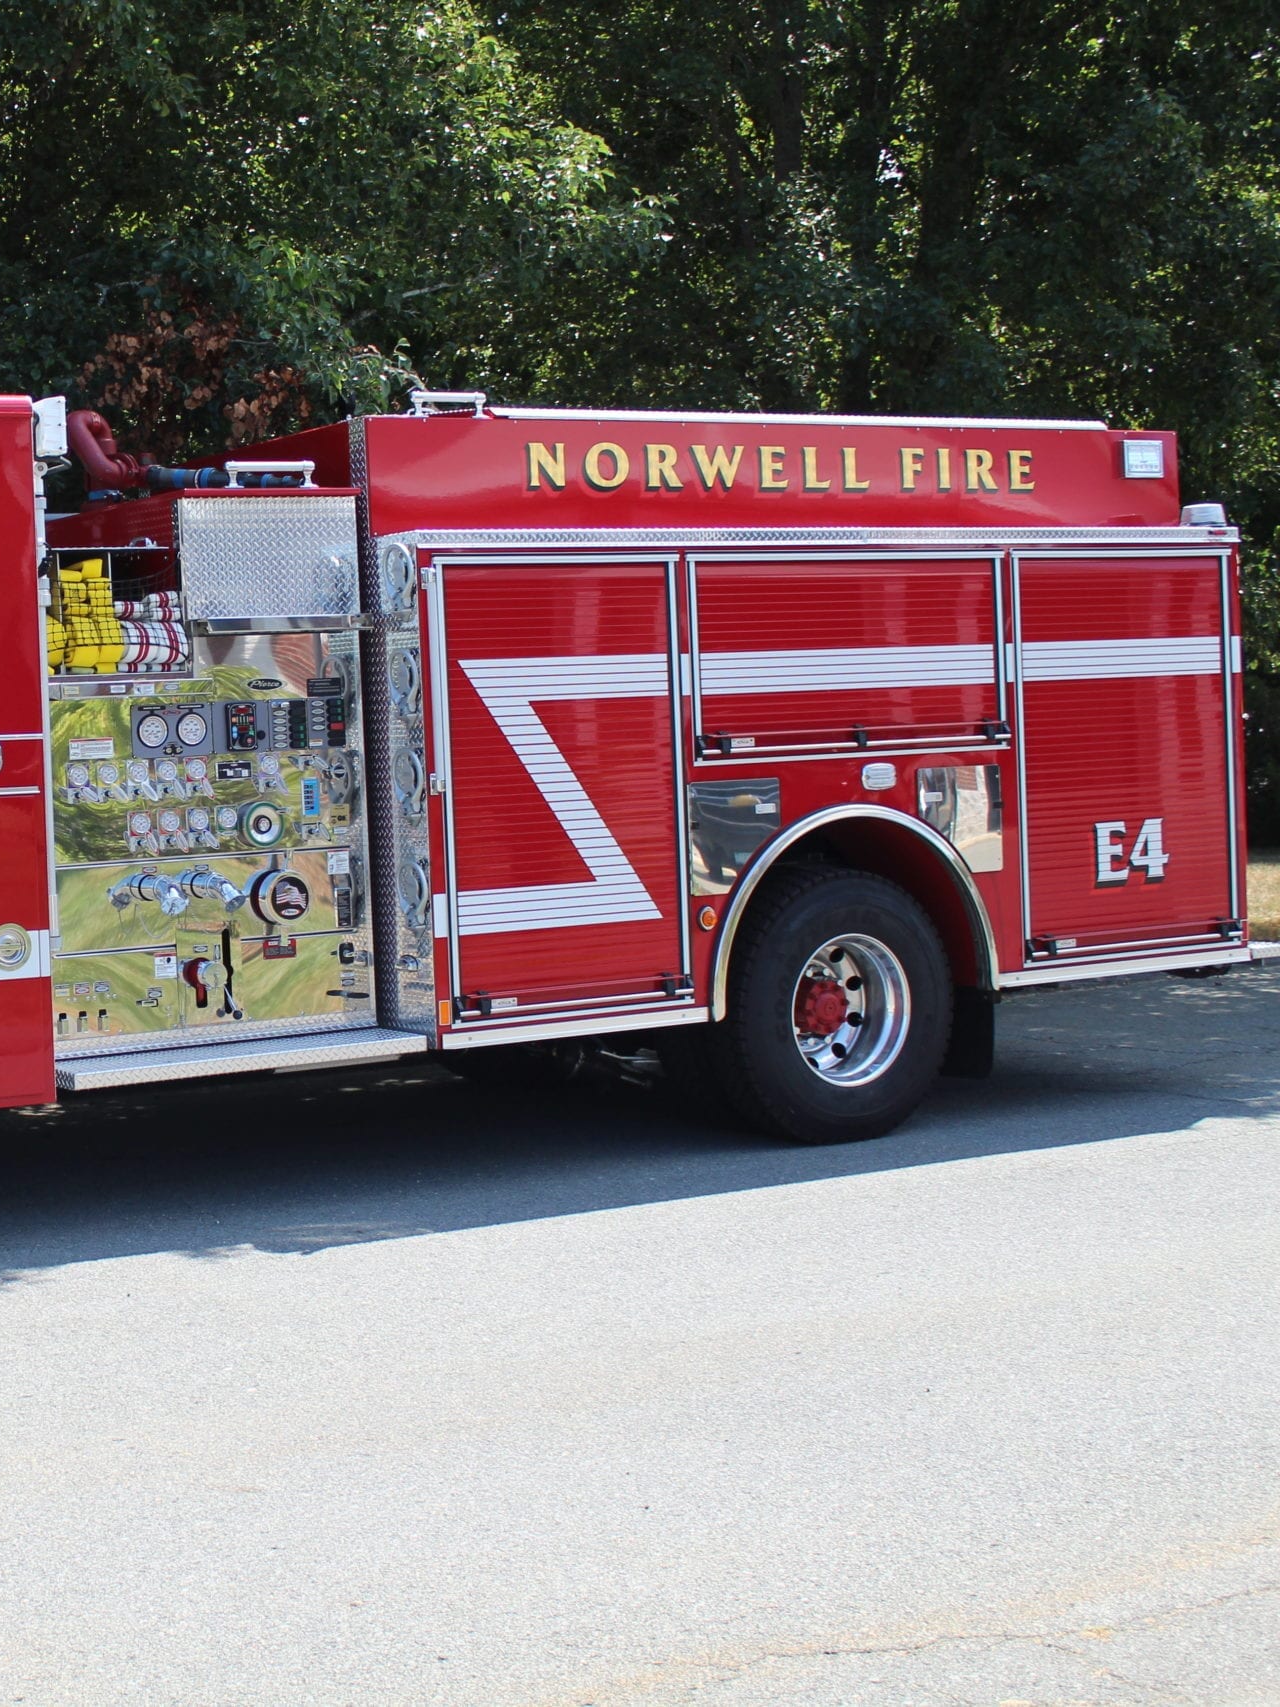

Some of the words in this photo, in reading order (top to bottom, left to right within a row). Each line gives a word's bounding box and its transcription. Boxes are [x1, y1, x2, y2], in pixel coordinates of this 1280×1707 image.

[526, 441, 871, 492] NORWELL
[899, 446, 1036, 492] FIRE
[1094, 817, 1170, 889] E4
